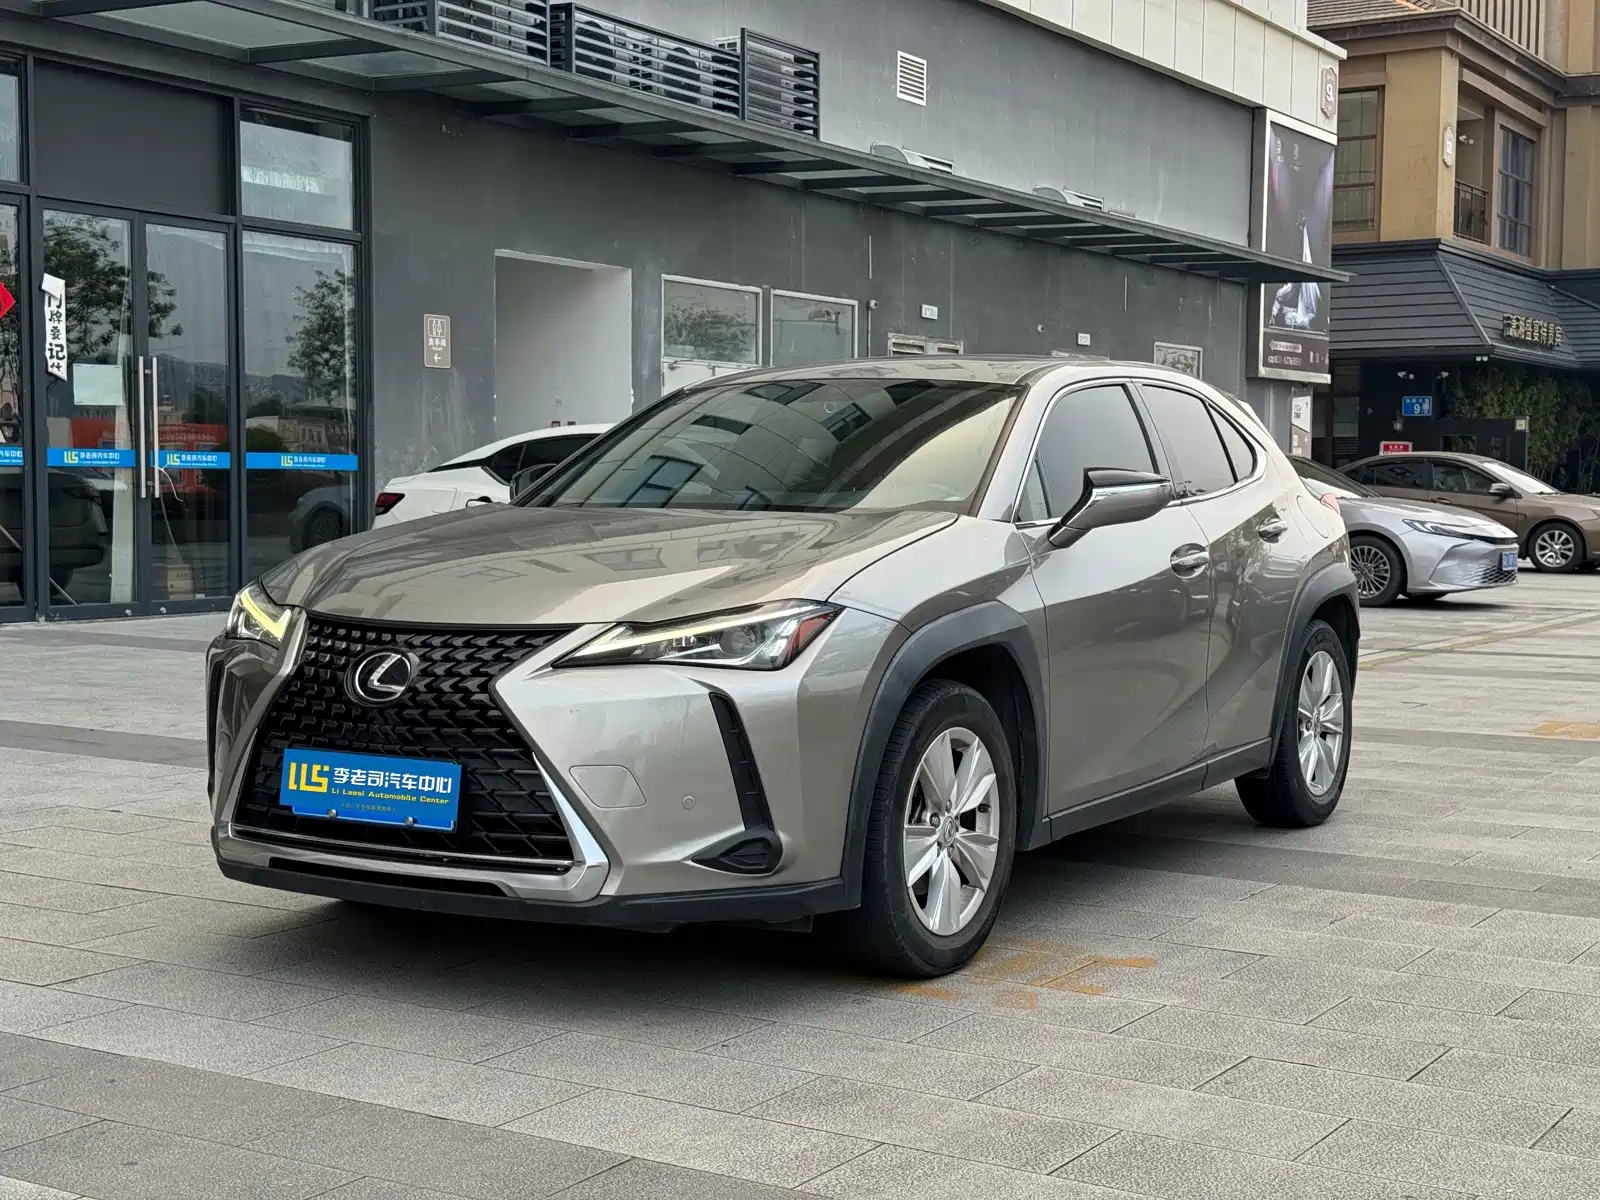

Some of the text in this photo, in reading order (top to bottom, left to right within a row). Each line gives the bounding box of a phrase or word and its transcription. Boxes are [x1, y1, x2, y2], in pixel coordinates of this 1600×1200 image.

[333, 767, 453, 794] 李老司汽车中心
[342, 788, 365, 797] Laosi
[368, 791, 417, 802] Automobile
[420, 795, 449, 804] Center
